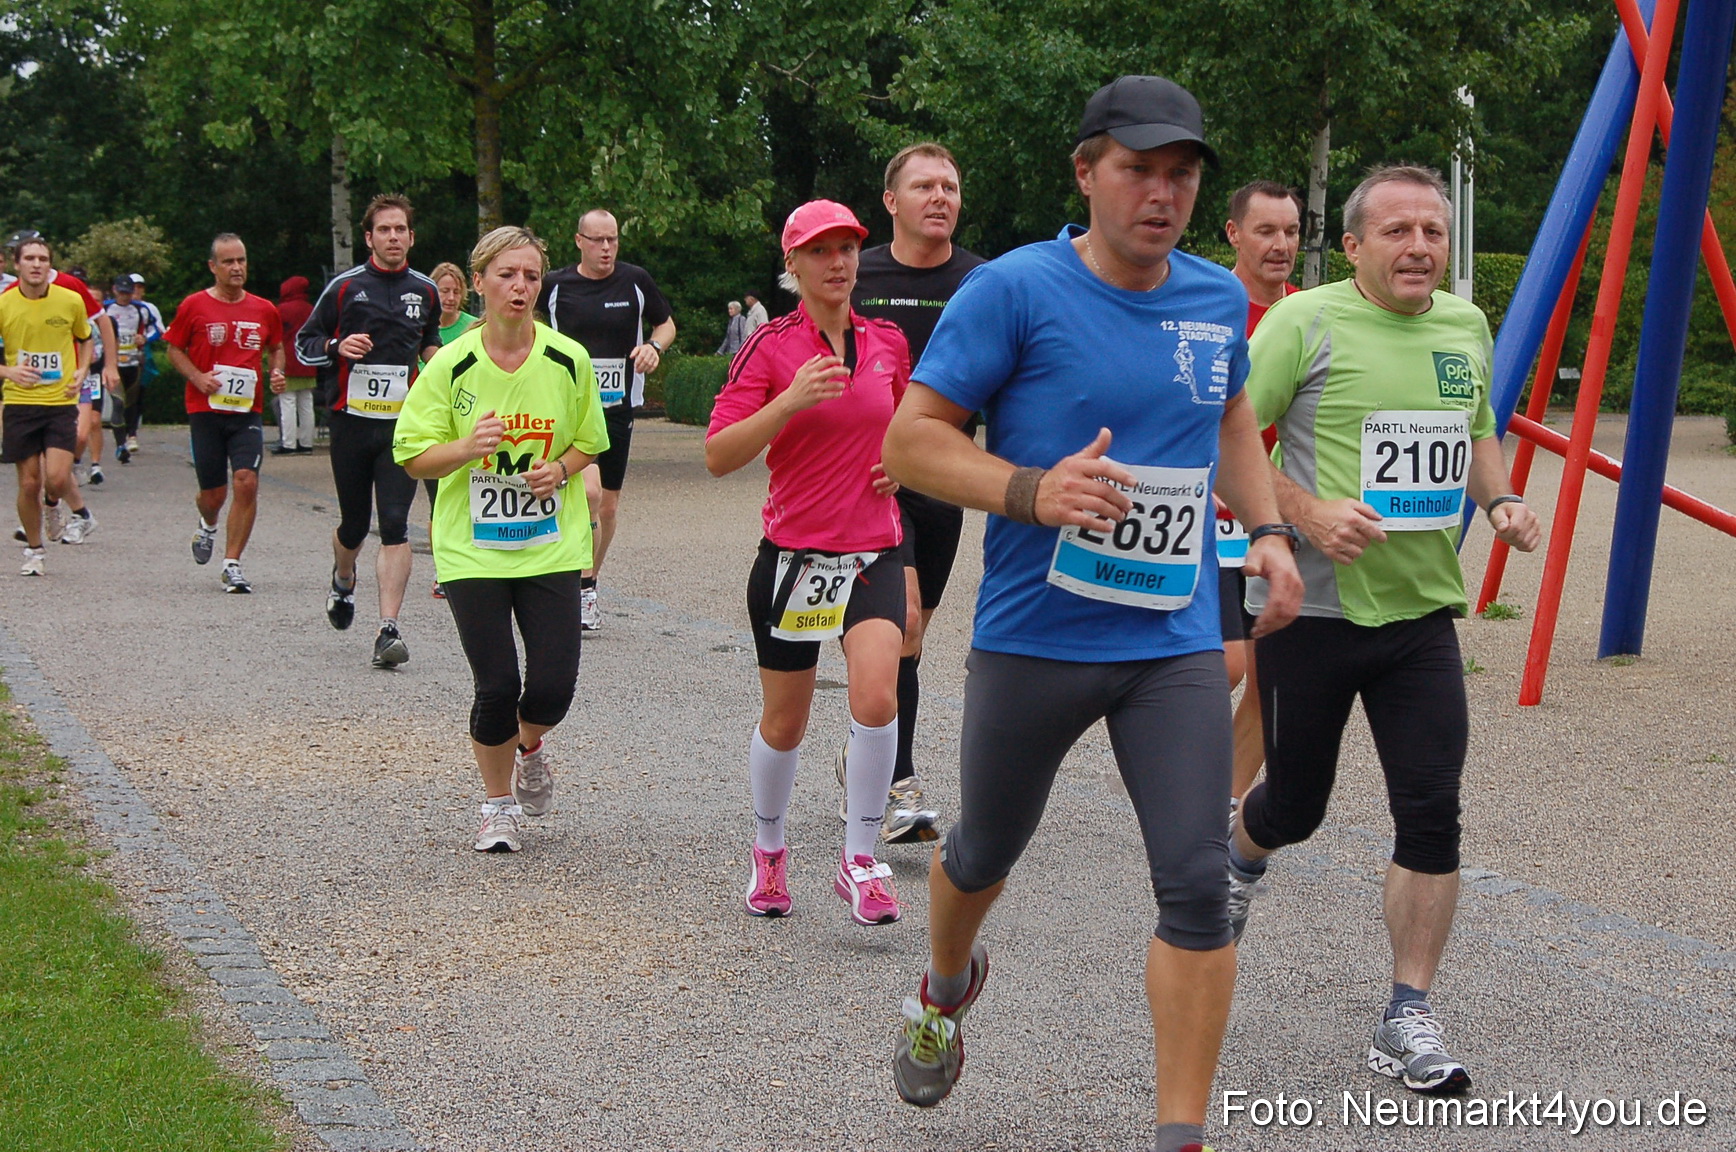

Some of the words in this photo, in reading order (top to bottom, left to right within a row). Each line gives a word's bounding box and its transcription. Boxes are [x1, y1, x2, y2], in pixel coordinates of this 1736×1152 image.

[890, 298, 918, 306] ROTHSEE
[405, 305, 420, 318] 44
[1160, 321, 1178, 330] 12.
[227, 379, 245, 395] 12
[368, 379, 391, 397] 97
[1440, 380, 1473, 395] Bank
[364, 402, 392, 411] Florian
[501, 413, 555, 431] üller
[1364, 423, 1406, 434] PARTL
[1410, 424, 1464, 434] Neumarkt
[1375, 440, 1467, 483] 2100
[472, 475, 502, 484] PARTL
[1133, 481, 1191, 497] Neumarkt
[1390, 496, 1452, 513] Reinhold
[498, 525, 538, 539] Monika
[1095, 560, 1166, 589] Werner
[807, 575, 846, 606] 38
